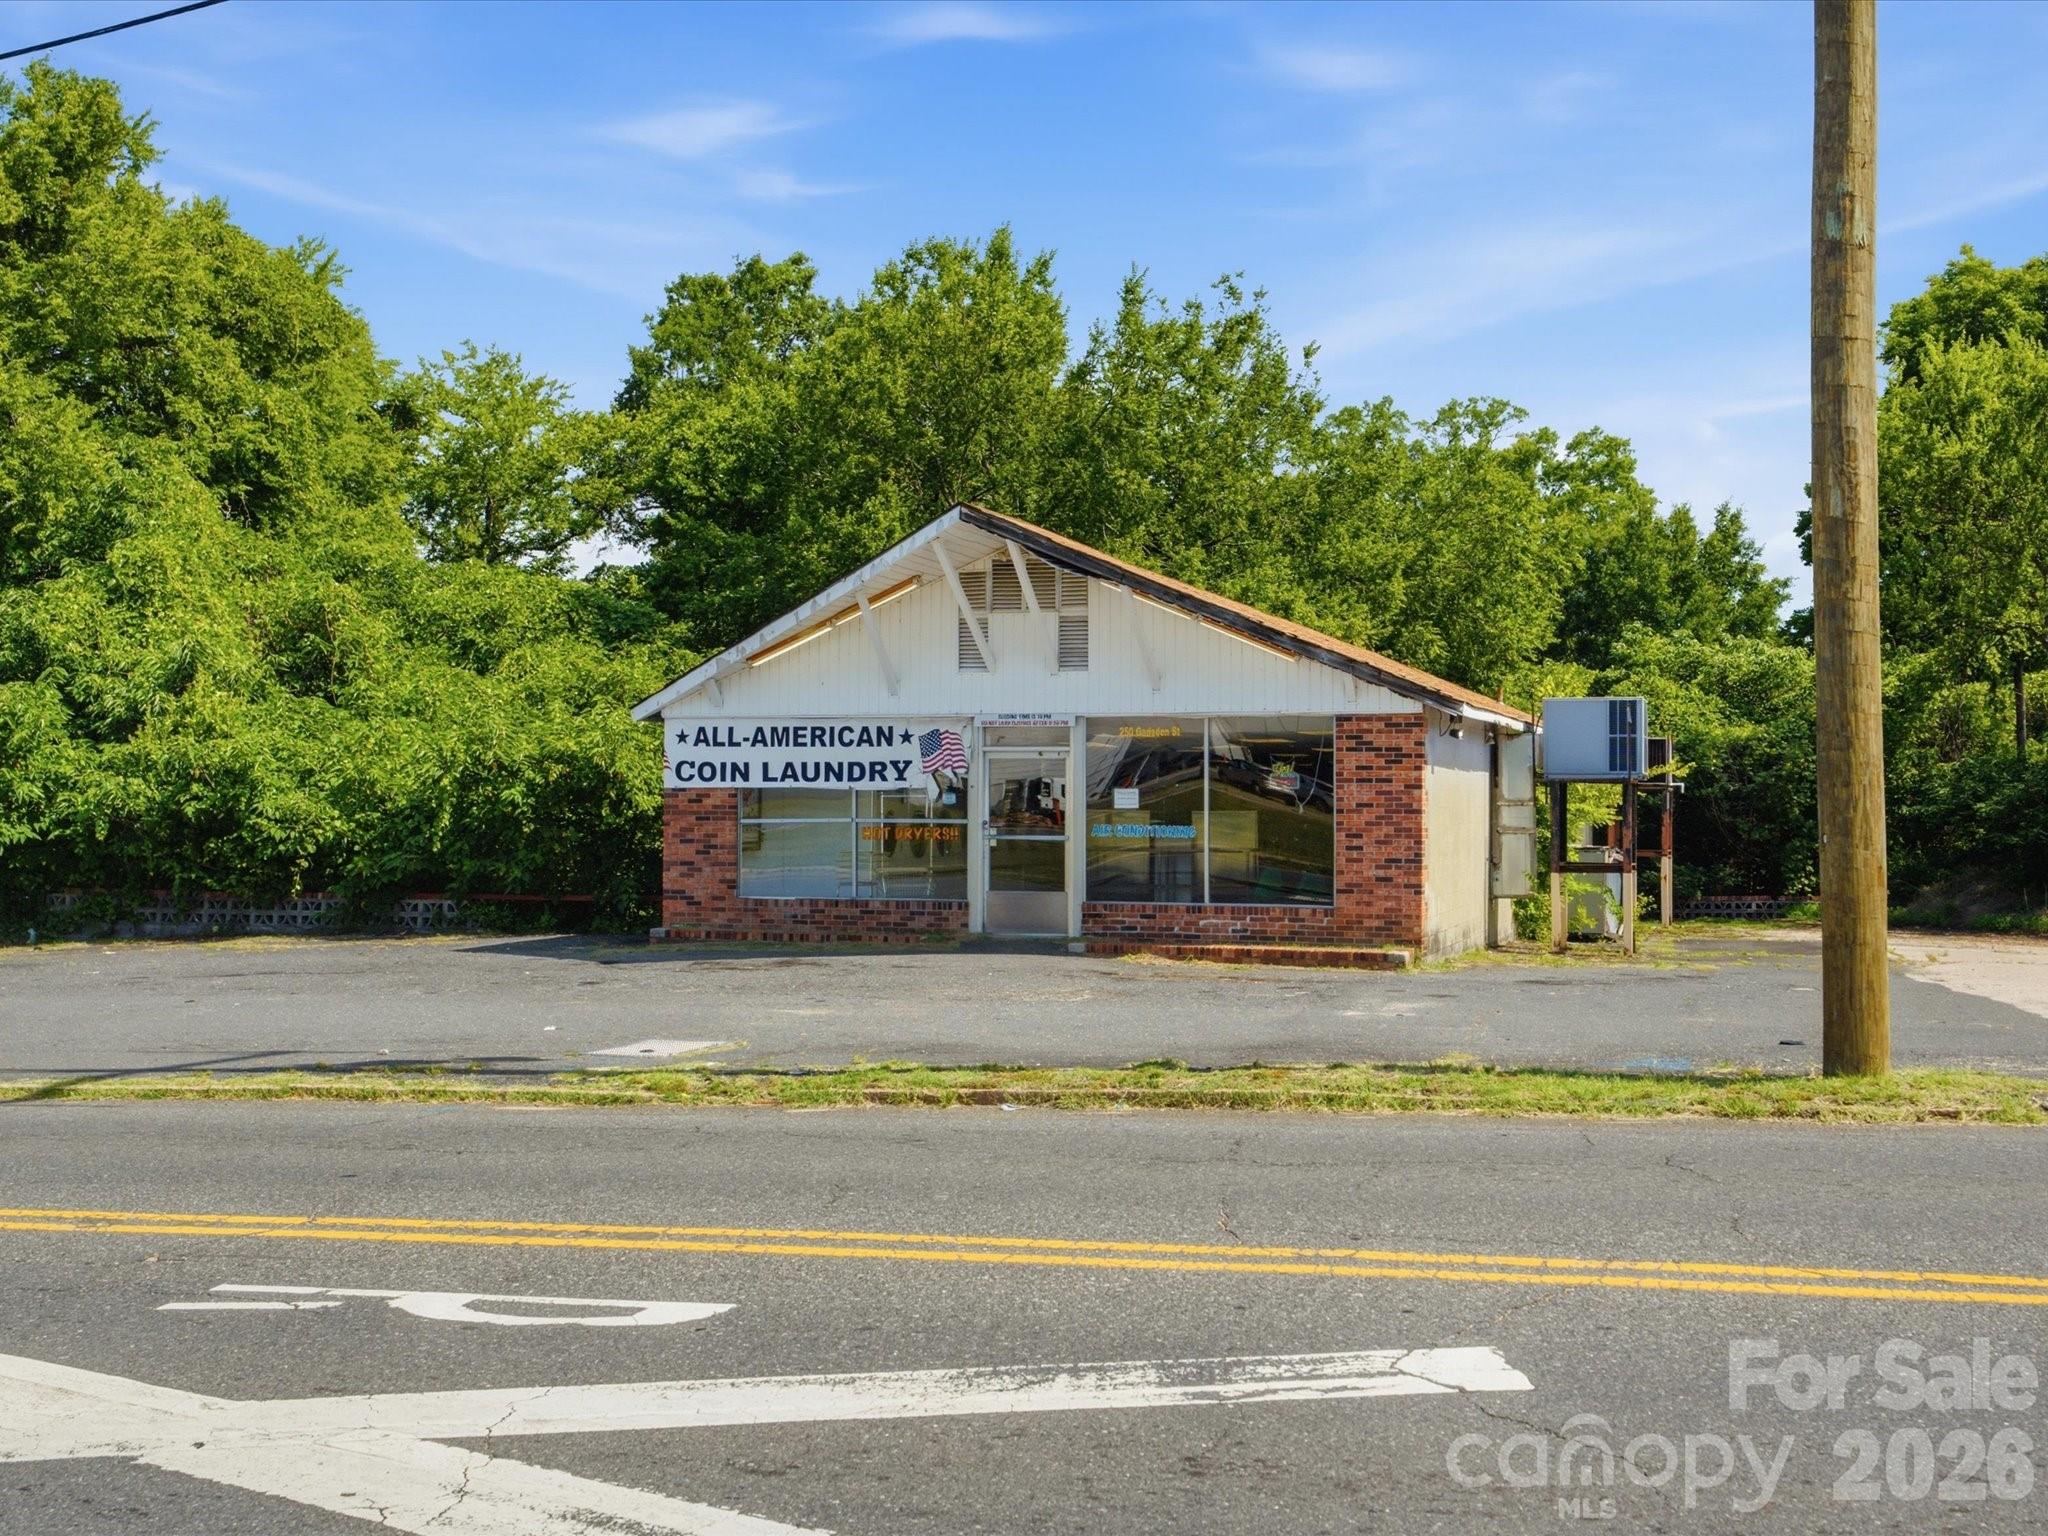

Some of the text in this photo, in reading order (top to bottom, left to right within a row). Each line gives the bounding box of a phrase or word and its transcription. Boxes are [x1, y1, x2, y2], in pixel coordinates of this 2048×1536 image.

[693, 725, 894, 748] ALL-AMERICAN
[1171, 726, 1181, 737] St
[675, 760, 913, 783] COIN LAUNDRY
[863, 826, 891, 841] HOT
